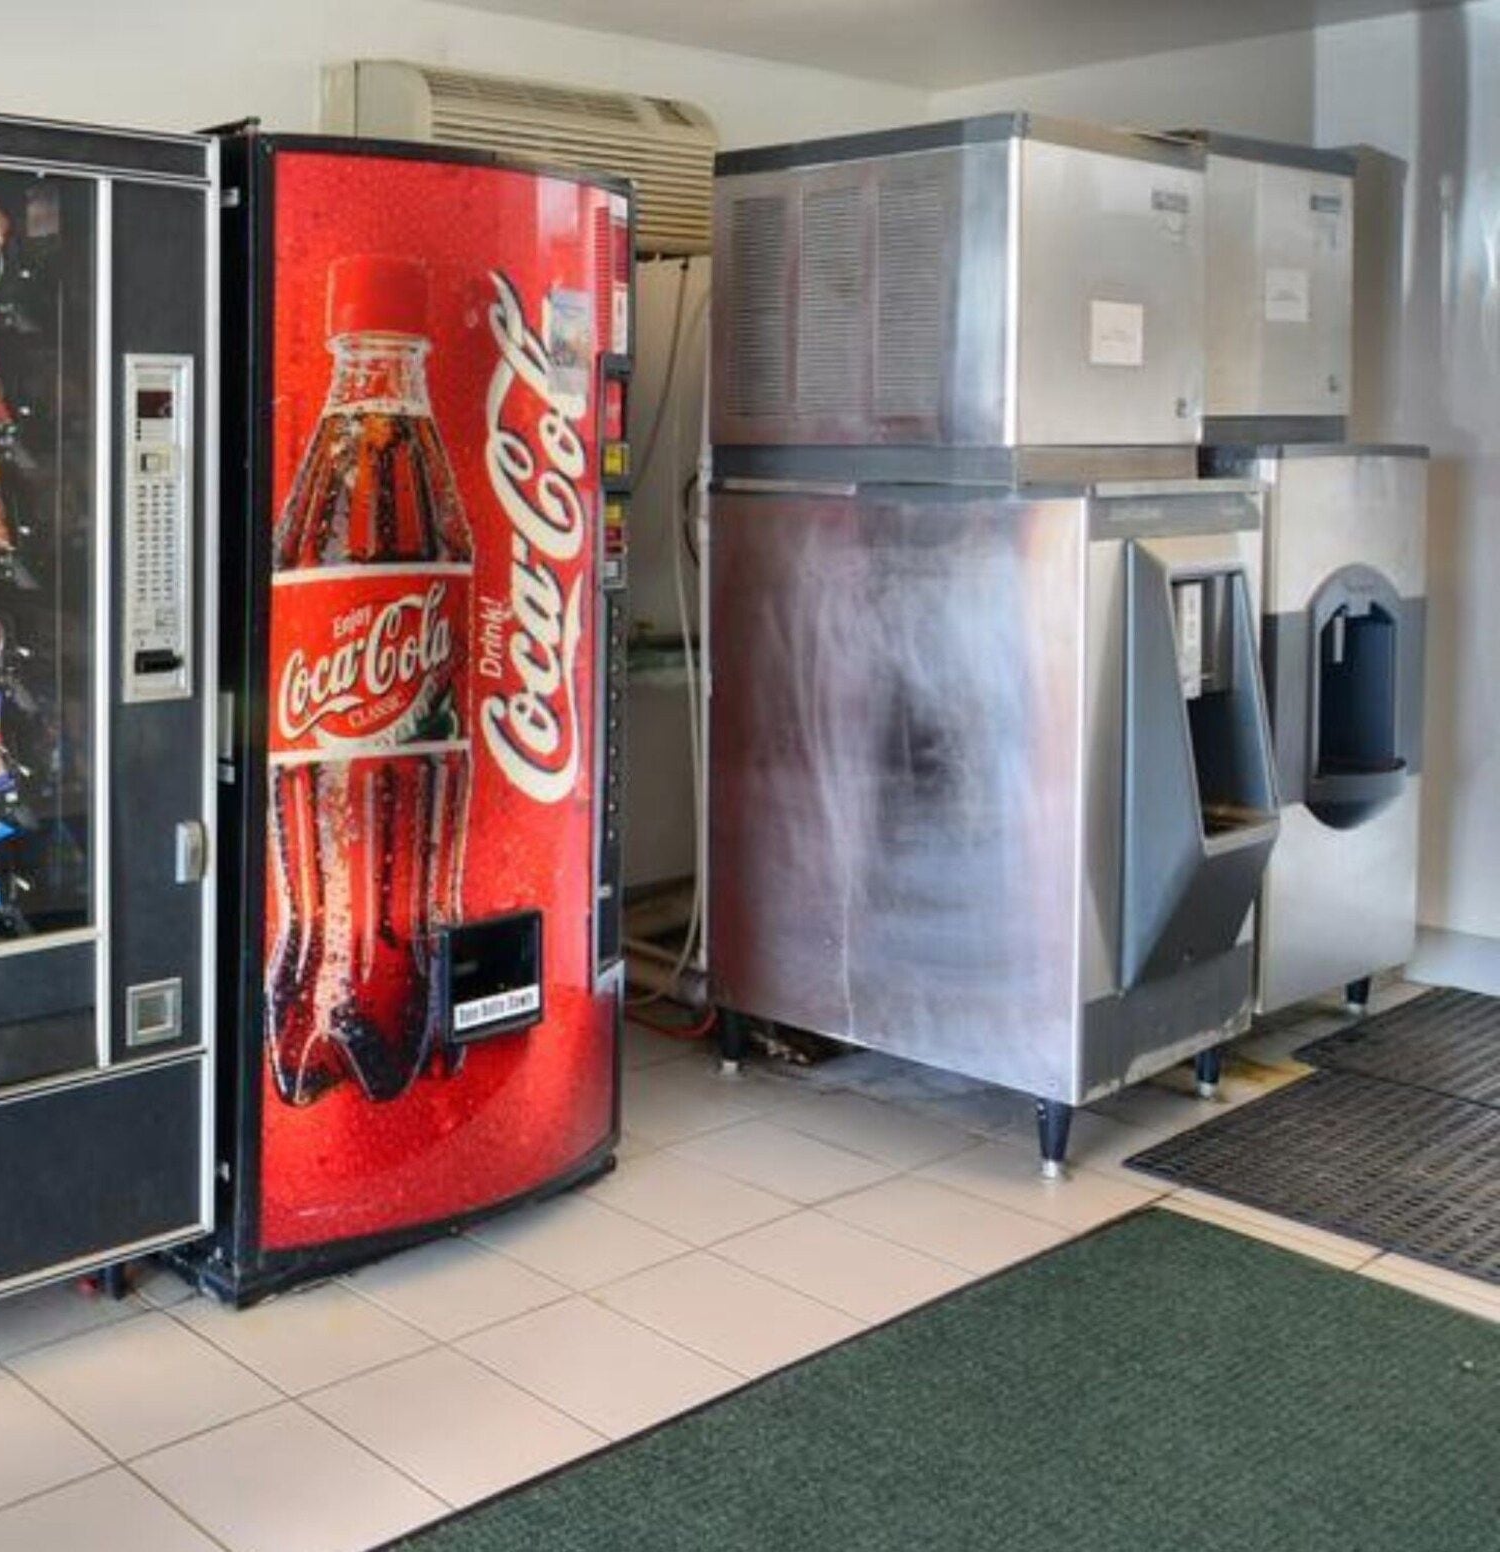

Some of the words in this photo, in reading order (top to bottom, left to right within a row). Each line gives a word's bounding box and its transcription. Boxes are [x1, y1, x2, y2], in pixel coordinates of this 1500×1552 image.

[480, 268, 588, 802] Coca-Col
[278, 580, 449, 740] Coca-Cola
[333, 606, 372, 639] Enjoy
[479, 595, 503, 679] Drink!
